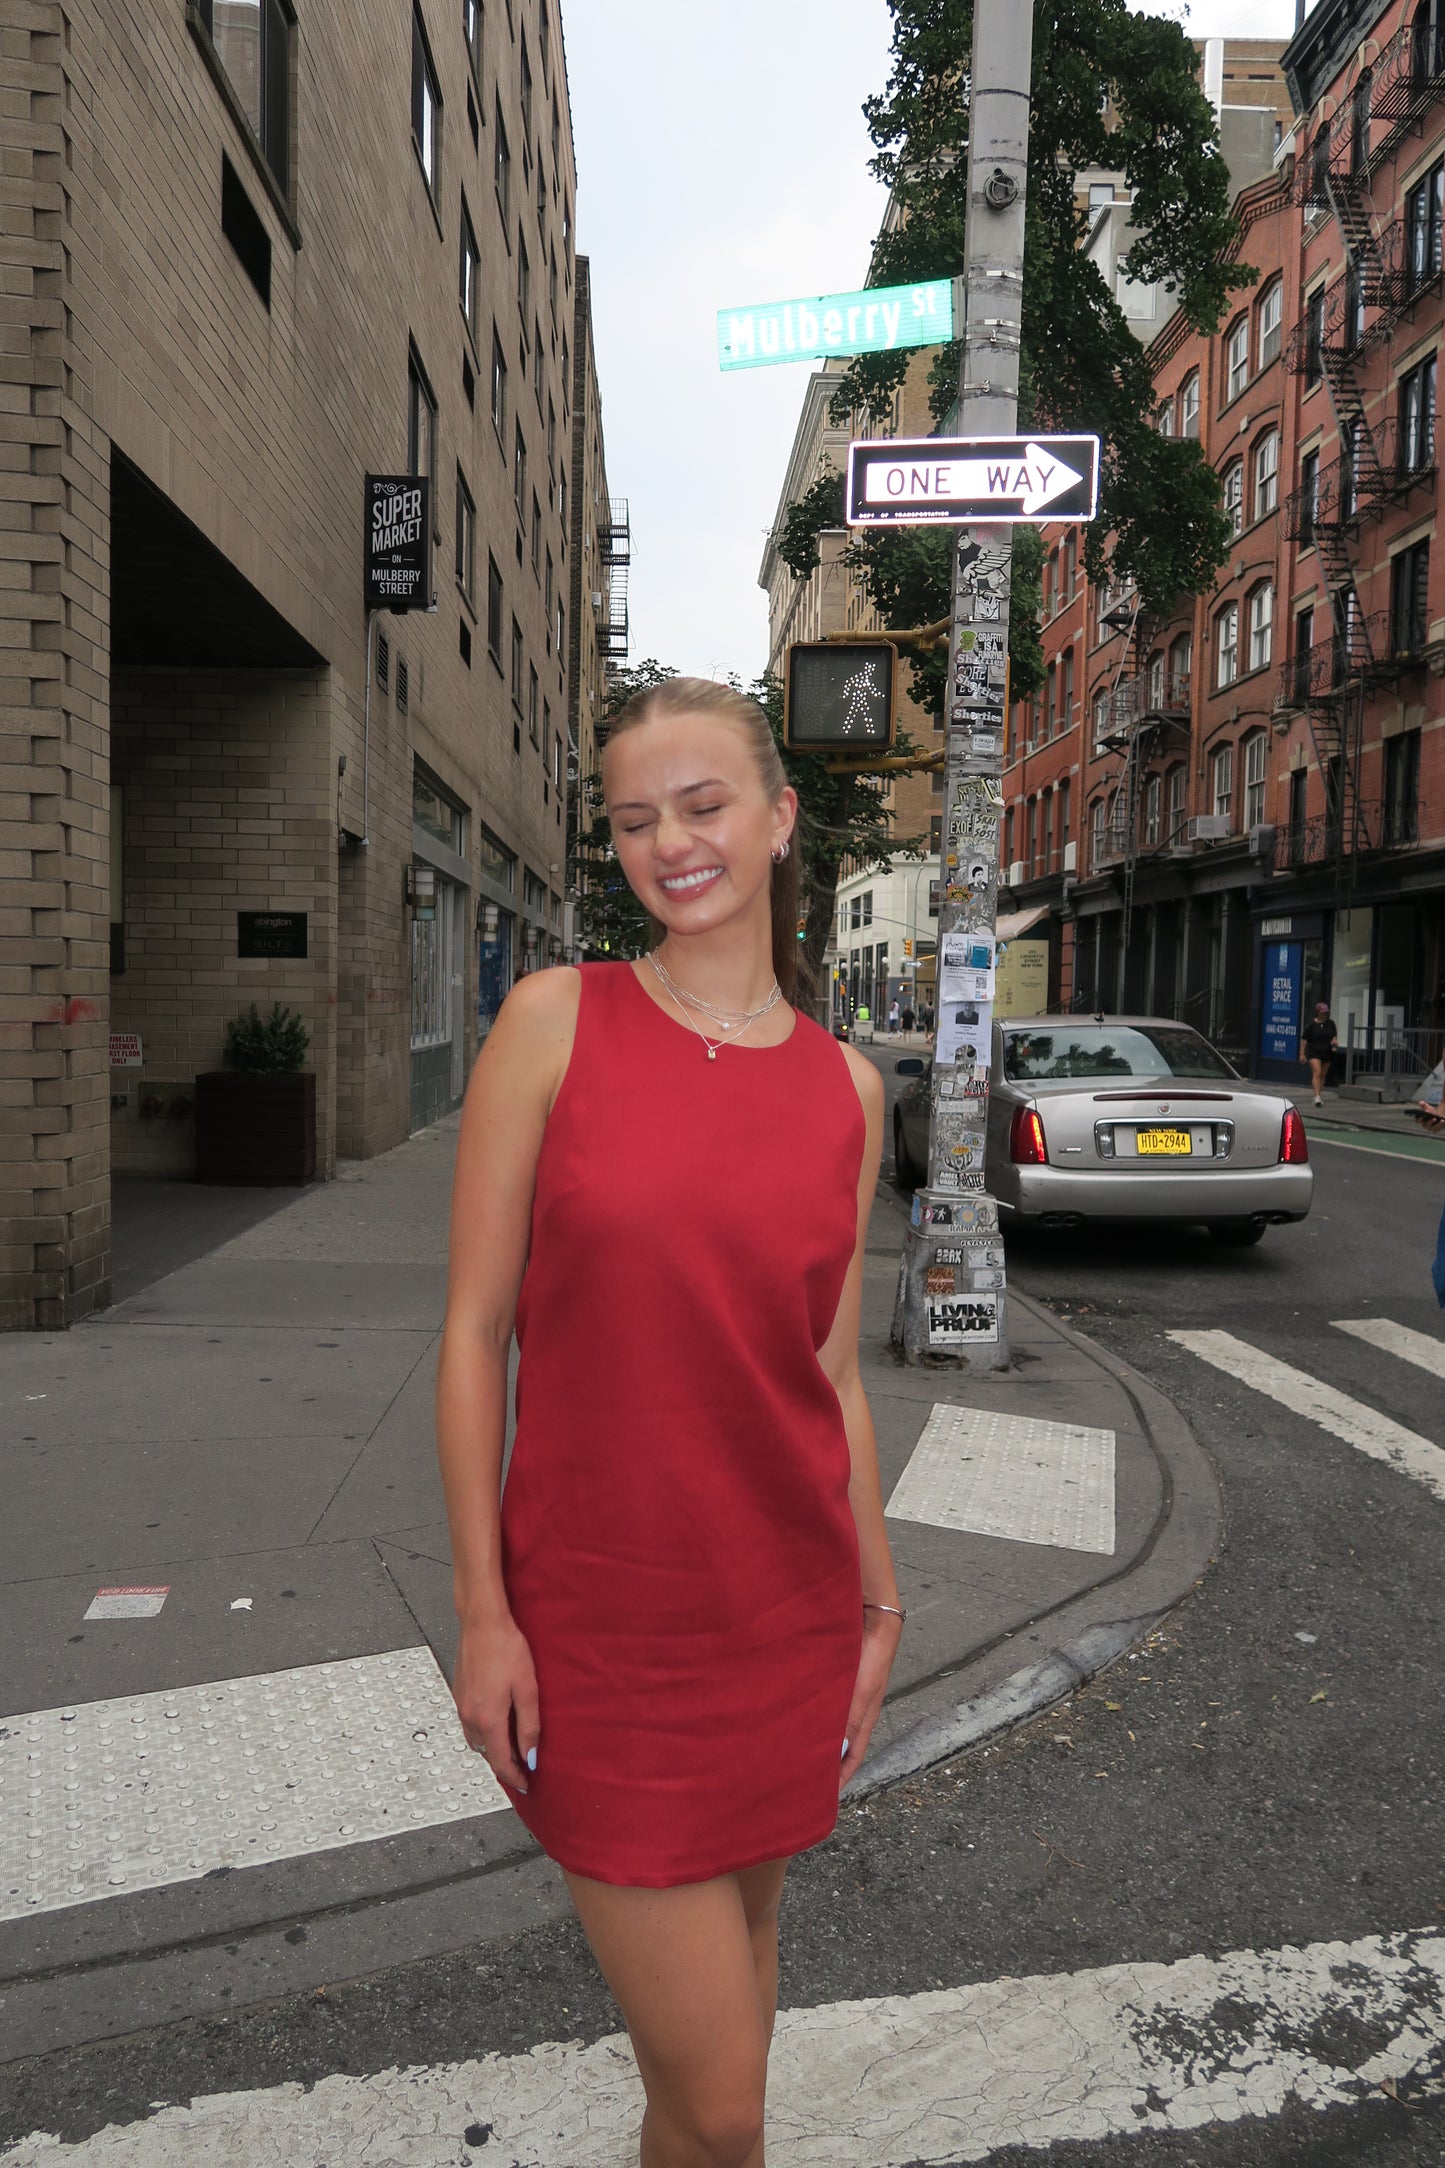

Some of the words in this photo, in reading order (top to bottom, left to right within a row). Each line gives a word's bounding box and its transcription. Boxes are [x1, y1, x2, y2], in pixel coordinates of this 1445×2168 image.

[728, 299, 900, 357] Mulberry
[912, 284, 936, 316] St
[886, 467, 952, 496] ONE
[987, 465, 1057, 494] WAY
[372, 488, 422, 530] SUPER
[894, 510, 950, 518] TRANSPORTATION
[372, 518, 423, 554] MARKET
[391, 554, 402, 564] ON
[372, 569, 421, 582] MULBERRY
[379, 582, 414, 595] STREET
[953, 708, 1002, 723] Shorties
[254, 917, 292, 928] abington
[1273, 977, 1292, 989] RETAIL
[1272, 990, 1291, 1002] SPACE
[1164, 1134, 1186, 1148] 2944
[930, 1317, 996, 1332] PROOF
